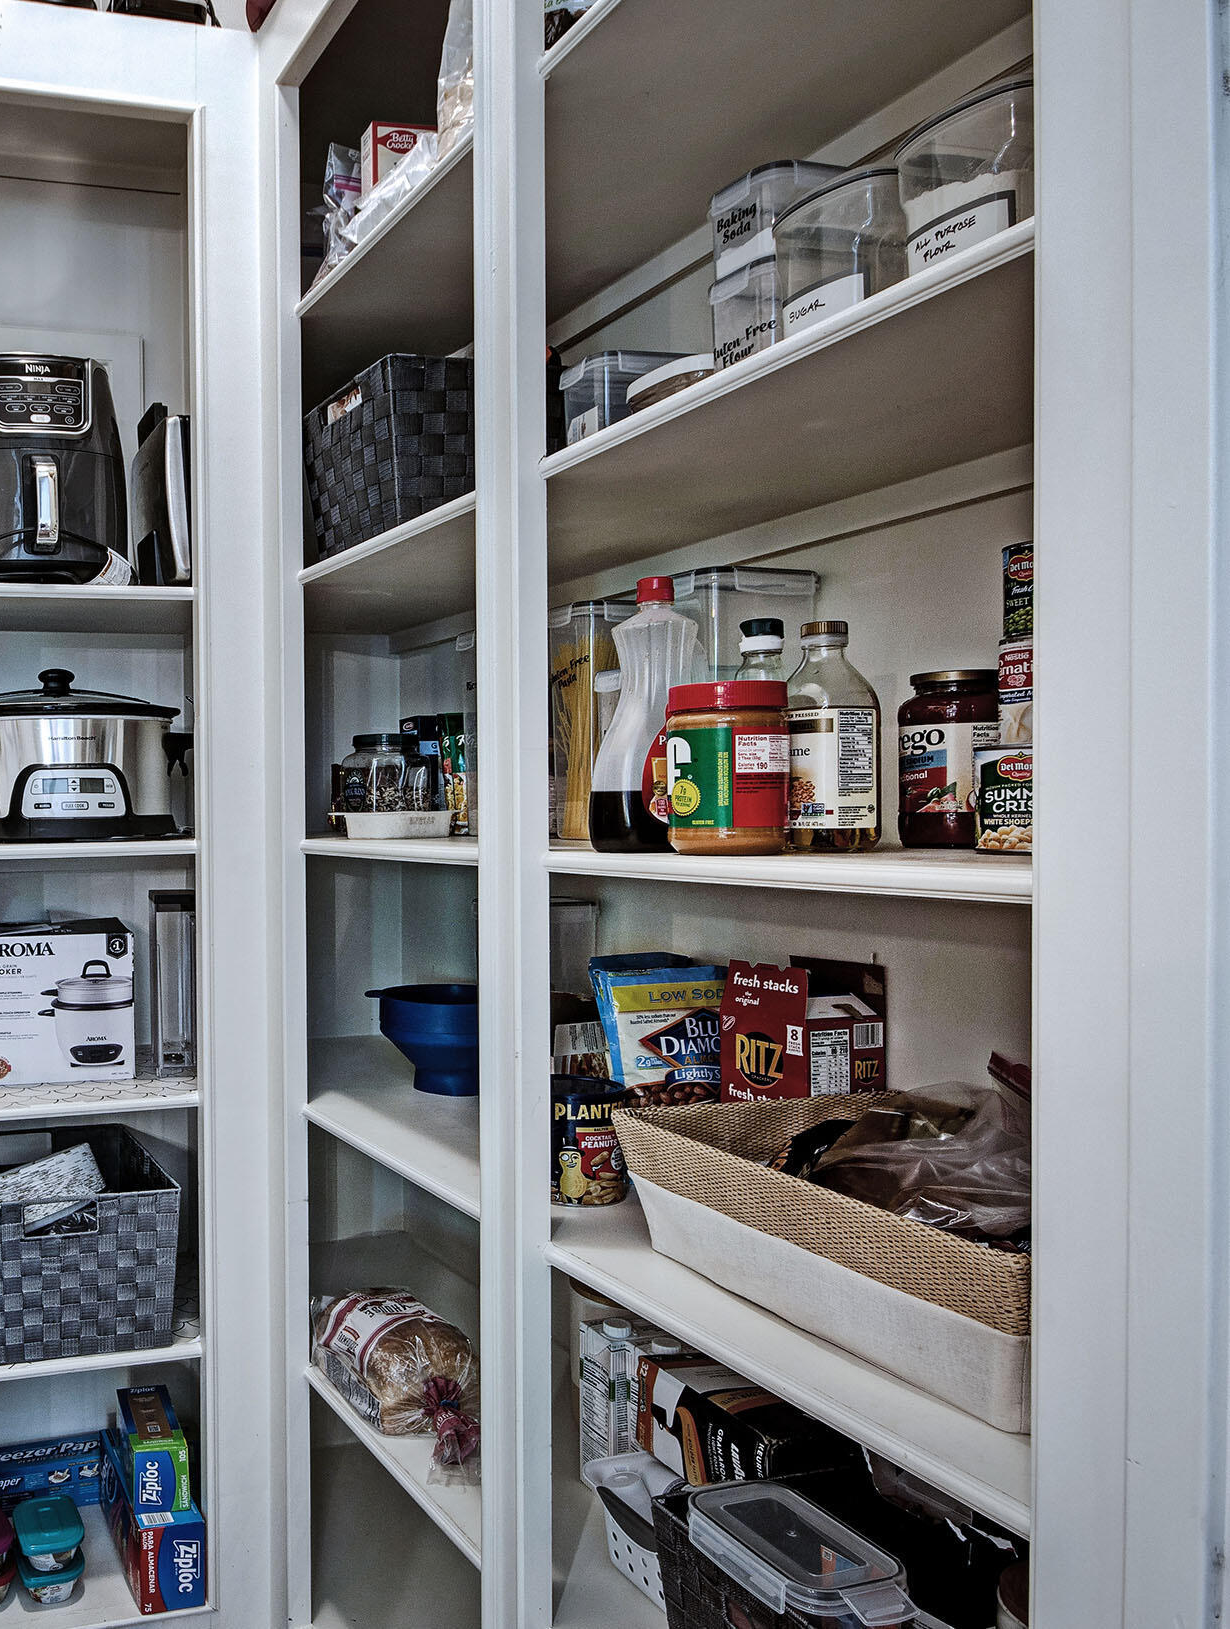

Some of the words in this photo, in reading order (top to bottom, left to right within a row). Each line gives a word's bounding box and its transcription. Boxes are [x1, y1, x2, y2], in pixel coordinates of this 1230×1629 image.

[390, 132, 414, 143] Betty
[717, 203, 757, 233] Baking
[722, 221, 751, 244] Soda
[915, 238, 931, 253] ALL
[934, 214, 976, 241] PURPOSE
[923, 240, 956, 262] FLOUR
[789, 299, 826, 324] SUGAR
[713, 319, 778, 362] luten-Free
[722, 343, 754, 369] Flour
[25, 363, 51, 375] NINJA
[1021, 560, 1034, 570] Mo
[1006, 597, 1030, 608] SWEET
[558, 673, 578, 690] Pasta
[795, 711, 819, 719] PRESSED
[899, 728, 945, 756] ego
[789, 748, 811, 757] ame
[1000, 763, 1014, 771] Del
[733, 972, 760, 988] fresh
[762, 979, 799, 995] stacks
[648, 990, 687, 1003] LOW
[734, 995, 759, 1006] original
[685, 1017, 719, 1038] BLU
[790, 1029, 798, 1041] 8
[637, 1056, 650, 1067] 2g
[735, 1033, 784, 1080] RITZ
[674, 1069, 714, 1080] Lightly
[854, 1060, 879, 1080] RITZ
[728, 1083, 754, 1101] fresh
[581, 1140, 618, 1149] PEANUTS
[640, 1361, 649, 1377] 32
[716, 1428, 724, 1455] GRAN
[755, 1443, 765, 1478] KEURIG
[141, 1461, 163, 1502] Ziploc
[182, 1474, 190, 1508] SANDWICH
[147, 1551, 156, 1594] ALMACENAR
[173, 1544, 198, 1593] Ziploc
[144, 1602, 152, 1613] 75
